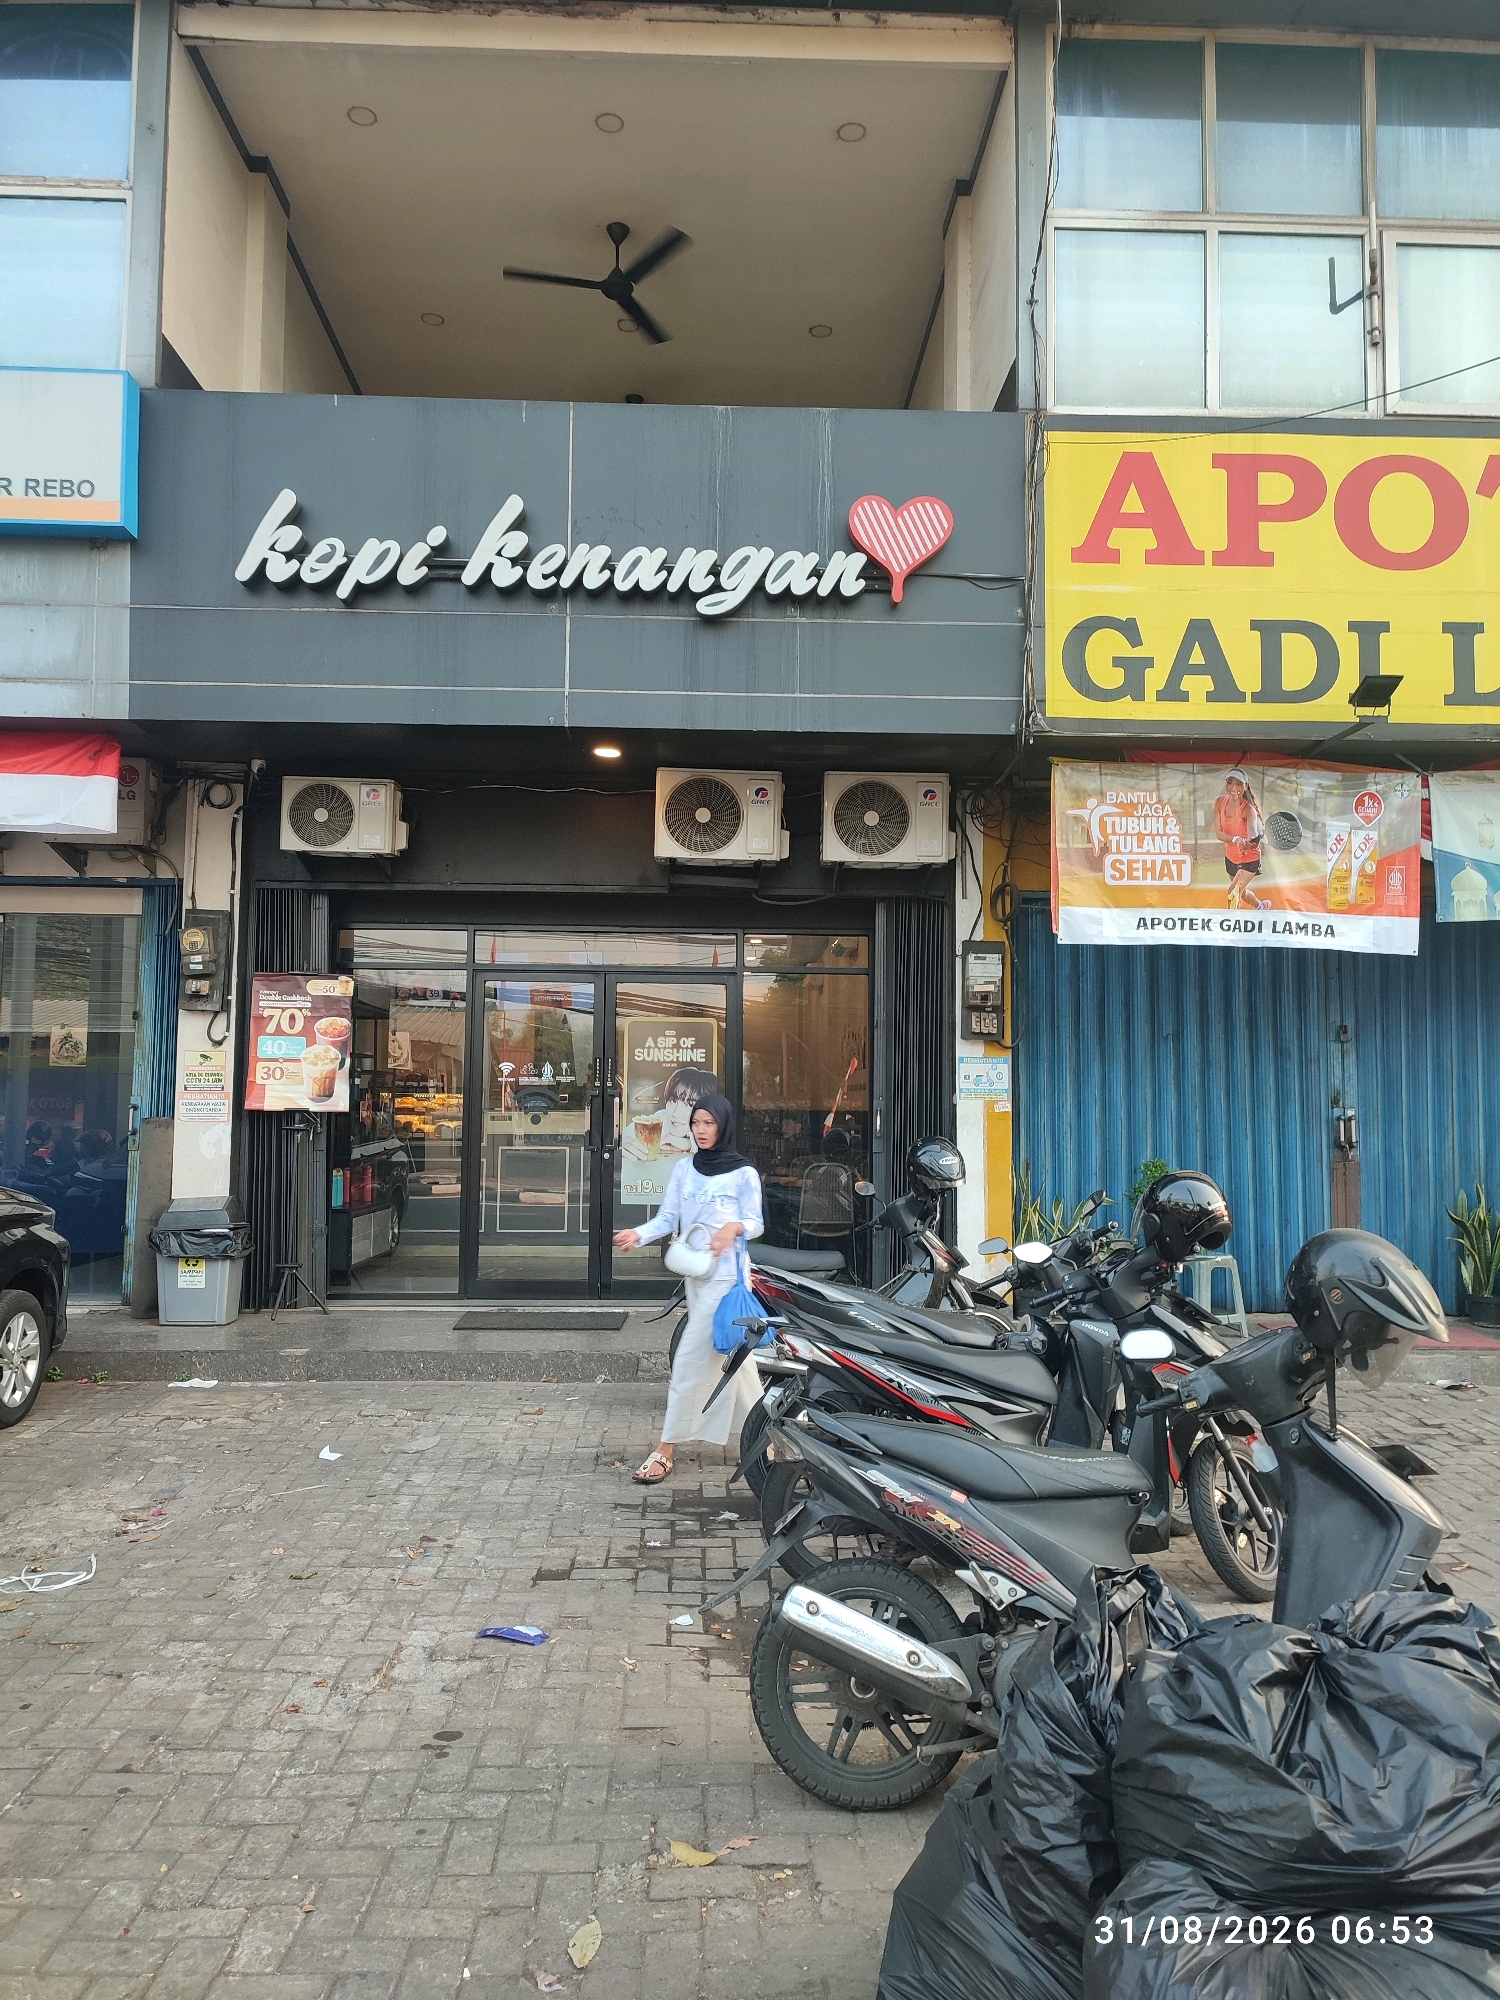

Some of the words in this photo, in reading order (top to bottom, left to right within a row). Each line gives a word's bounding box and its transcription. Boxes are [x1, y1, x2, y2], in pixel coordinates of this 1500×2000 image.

[24, 478, 95, 498] REBO
[1071, 451, 1500, 571] APO
[235, 488, 450, 602] kopi
[461, 493, 869, 618] kenangan
[1062, 615, 1391, 705] GADI
[118, 790, 136, 800] LG
[1106, 791, 1157, 804] BANTU
[1134, 804, 1173, 816] JAGA
[1104, 817, 1163, 834] TUBUH
[1166, 818, 1180, 835] &
[1109, 836, 1180, 853] TULANG
[1353, 832, 1374, 860] CDR
[1110, 859, 1186, 881] SEHAT
[1136, 917, 1213, 932] APOTEK
[1219, 918, 1263, 934] GADI
[1272, 920, 1336, 938] LAMBA
[282, 994, 312, 1002] Cashback
[645, 1037, 655, 1048] A
[657, 1037, 676, 1048] SIP
[680, 1037, 696, 1048] OF
[634, 1048, 706, 1062] SUNSHINE
